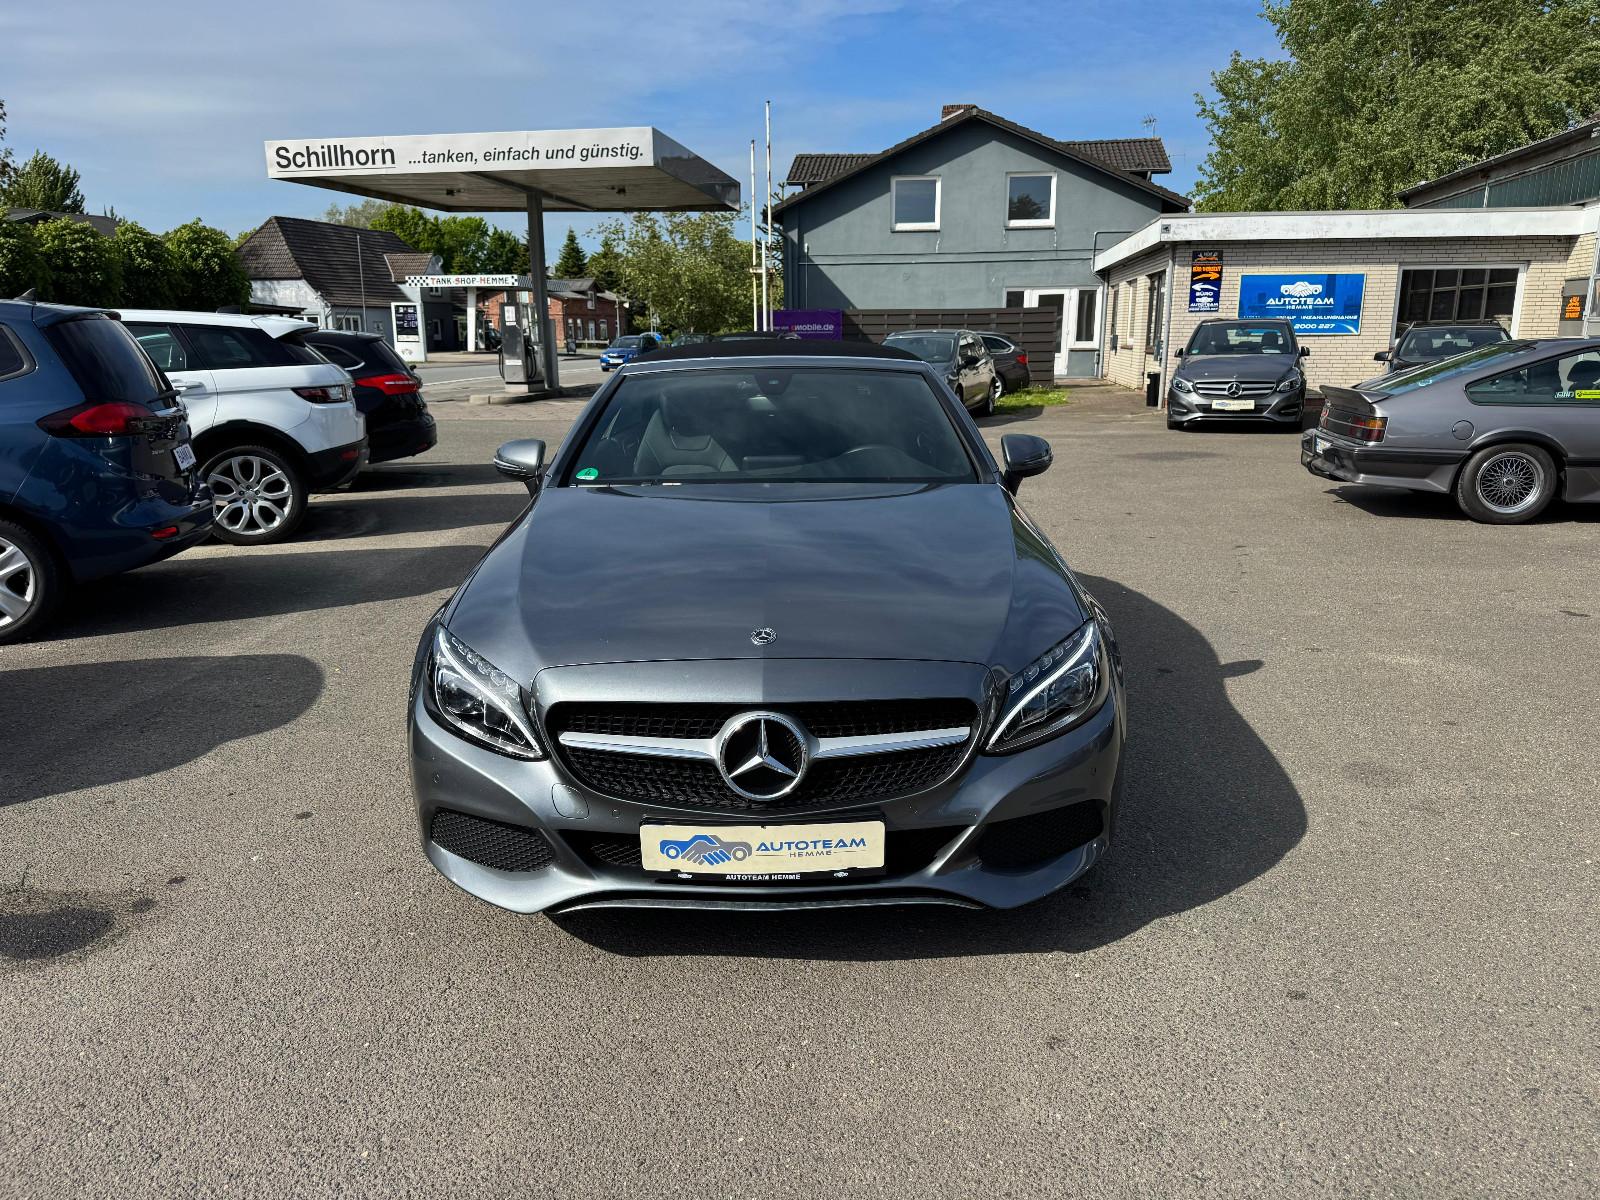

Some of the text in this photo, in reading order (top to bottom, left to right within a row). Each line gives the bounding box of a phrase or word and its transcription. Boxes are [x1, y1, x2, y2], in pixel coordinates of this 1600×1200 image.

[275, 144, 396, 169] Schillhorn
[483, 146, 540, 162] einfach
[545, 144, 575, 160] und
[580, 142, 644, 162] günstig.
[1266, 297, 1335, 305] AUTOTEAM
[755, 838, 867, 852] AUTOTEAM
[789, 850, 832, 858] HEMME
[725, 873, 770, 881] AUTOTEAM
